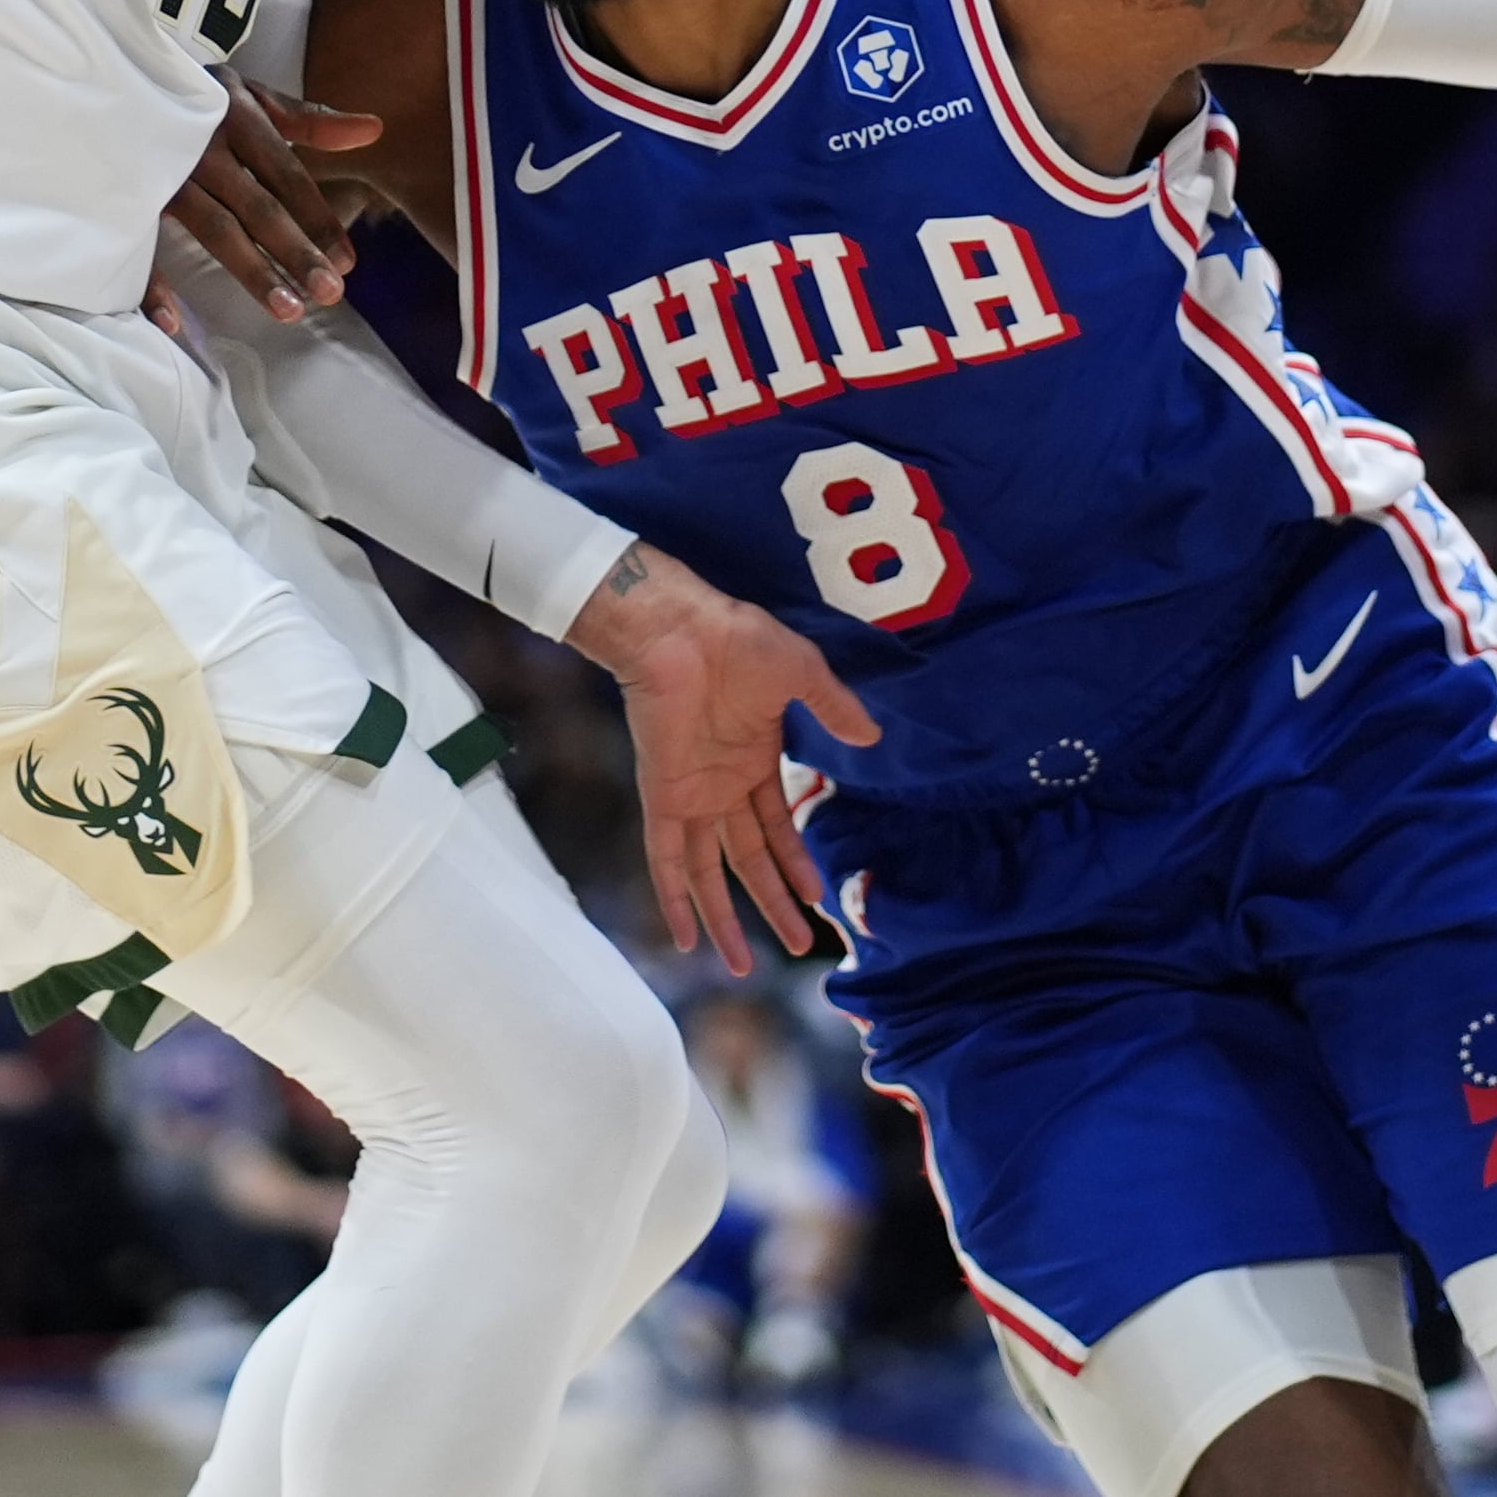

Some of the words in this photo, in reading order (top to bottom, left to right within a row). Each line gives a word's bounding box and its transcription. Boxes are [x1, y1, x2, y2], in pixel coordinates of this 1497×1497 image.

[827, 96, 974, 152] crypto.com
[521, 214, 1081, 467] PHILA
[780, 441, 972, 633] 8
